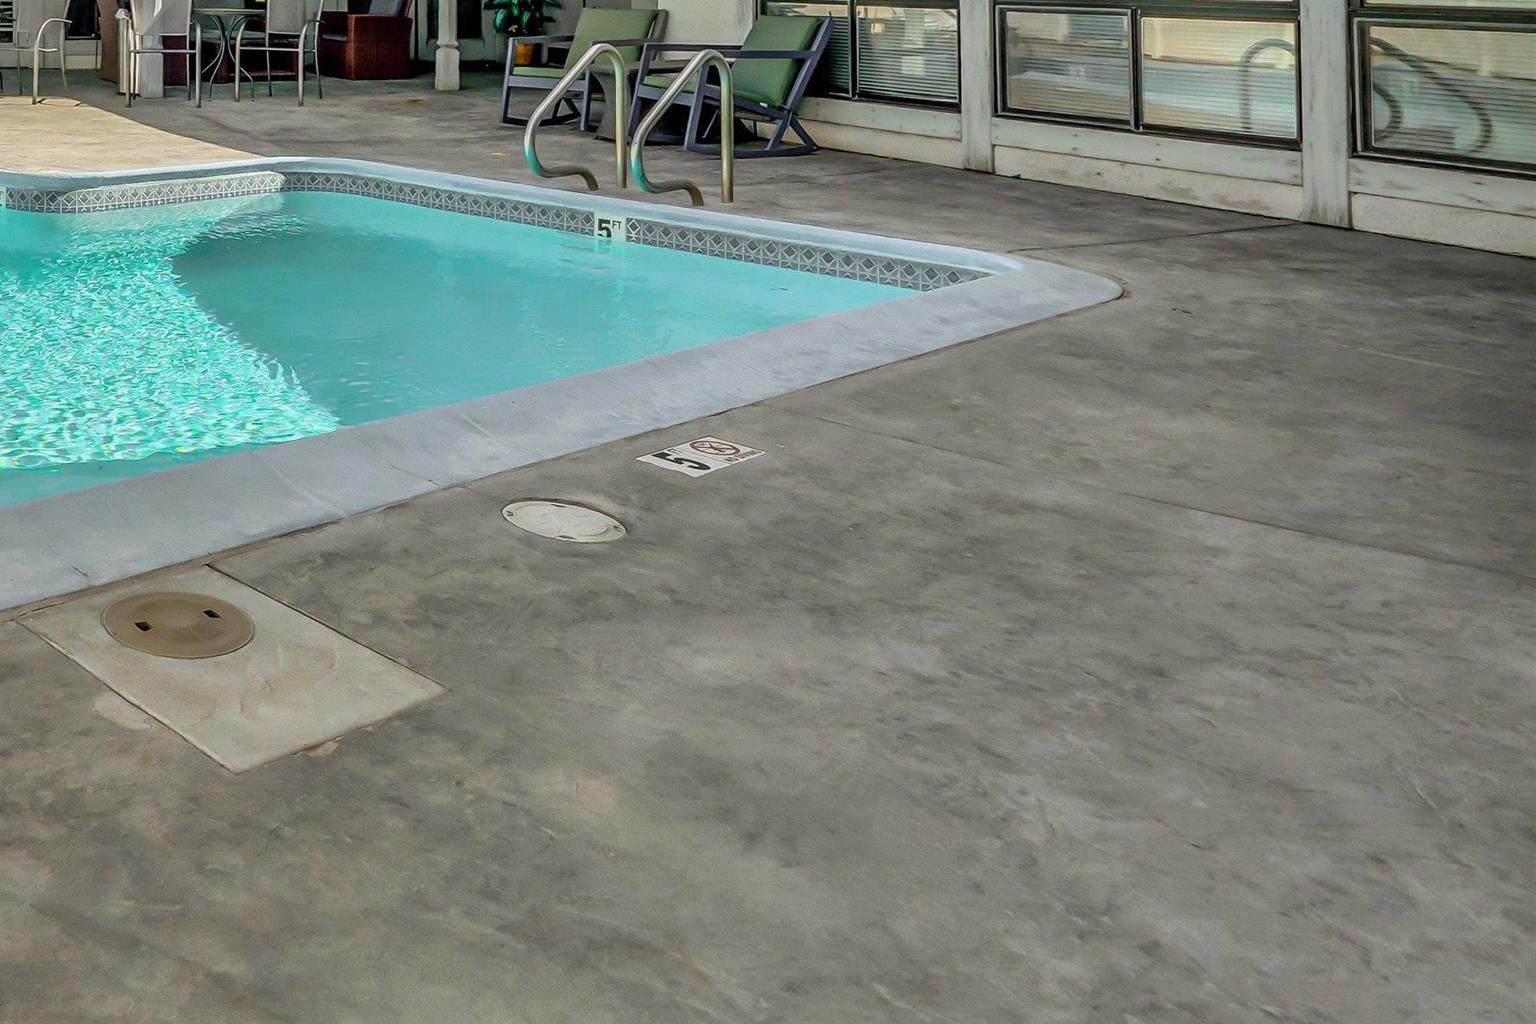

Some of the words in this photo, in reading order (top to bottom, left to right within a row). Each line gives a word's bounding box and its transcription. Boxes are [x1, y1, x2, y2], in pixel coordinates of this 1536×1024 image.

[597, 218, 612, 238] 5
[612, 220, 622, 230] FT
[651, 451, 711, 471] 5
